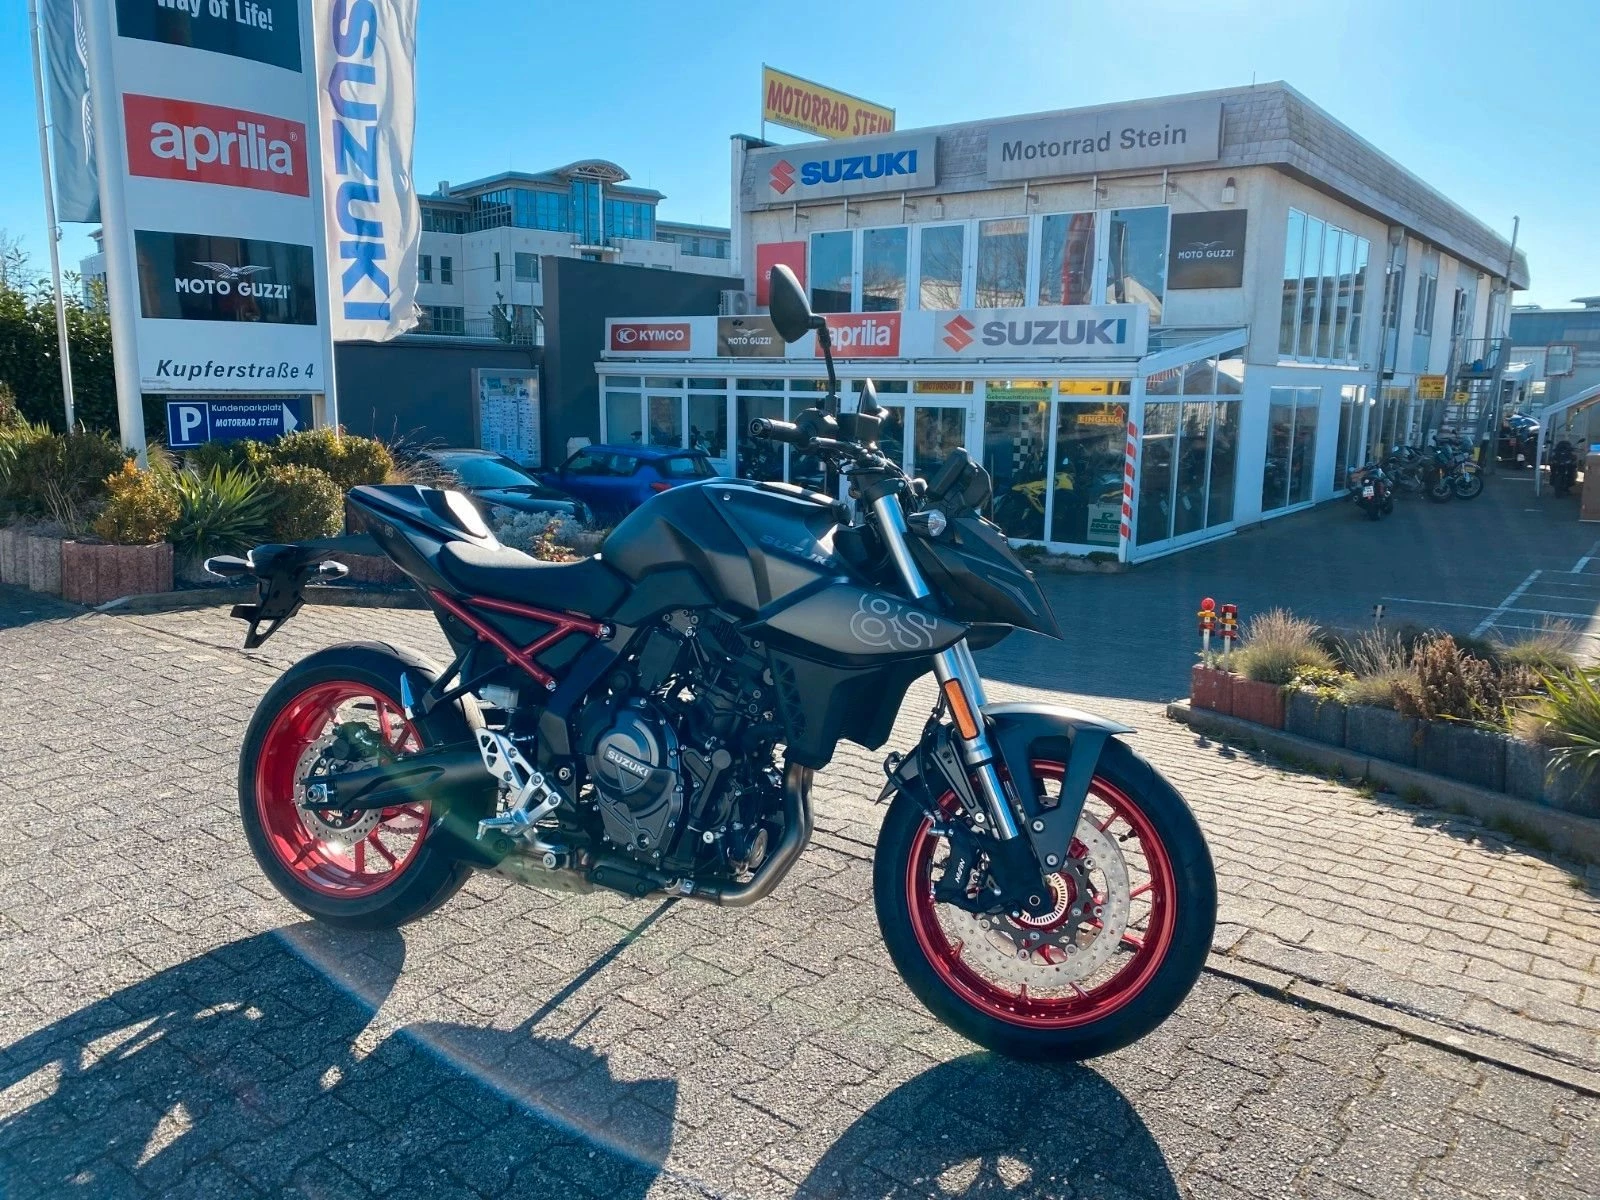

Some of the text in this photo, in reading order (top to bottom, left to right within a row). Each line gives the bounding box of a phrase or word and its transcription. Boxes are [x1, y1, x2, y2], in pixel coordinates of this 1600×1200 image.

[157, 0, 273, 32] ay of Life!
[766, 79, 849, 132] MOTORRAD
[150, 120, 293, 176] aprilia
[1002, 124, 1187, 162] Motorrad Stein
[328, 0, 391, 321] SUZUKI
[801, 150, 918, 186] SUZUKI
[1178, 249, 1234, 260] MOTO GUZZI
[174, 277, 288, 300] MOTO GUZZI
[639, 329, 685, 342] KYMCO
[727, 336, 772, 346] MOTO GUZZI
[982, 318, 1127, 346] SUZUKI
[156, 359, 314, 381] Kupferstraße 4
[211, 404, 282, 413] Kundenparkplatz
[215, 417, 279, 427] MOTORRAD STEIN
[1079, 415, 1121, 424] EINGANG
[178, 406, 202, 442] P
[607, 750, 649, 777] SUZUKI
